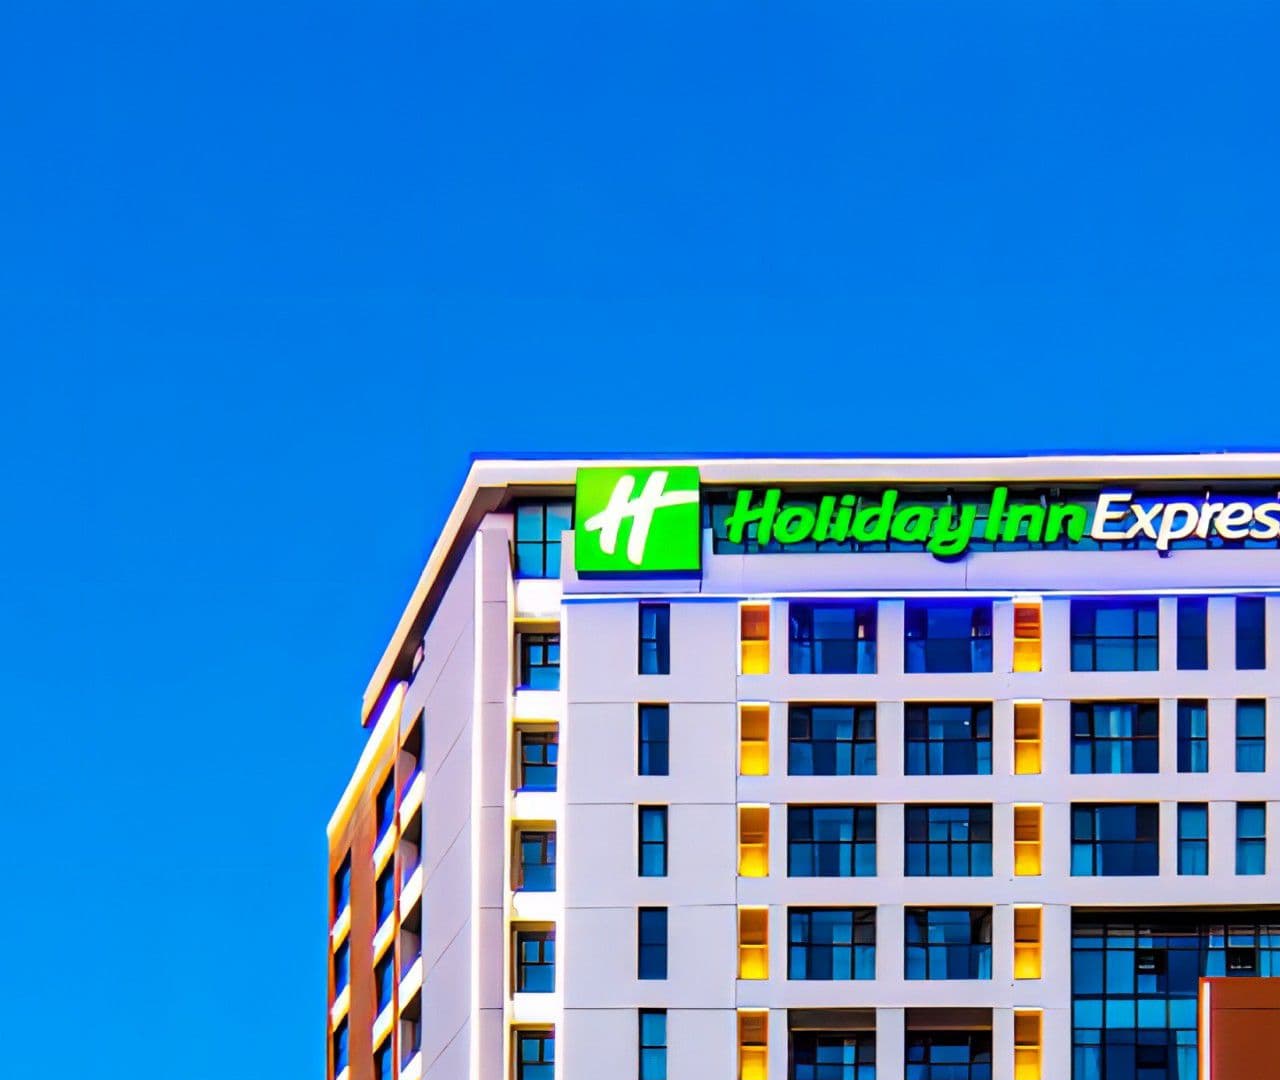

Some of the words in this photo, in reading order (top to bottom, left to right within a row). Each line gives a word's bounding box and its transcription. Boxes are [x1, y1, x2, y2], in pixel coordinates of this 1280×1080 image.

[584, 471, 699, 566] H
[725, 489, 977, 555] Holiday
[984, 487, 1088, 543] Inn
